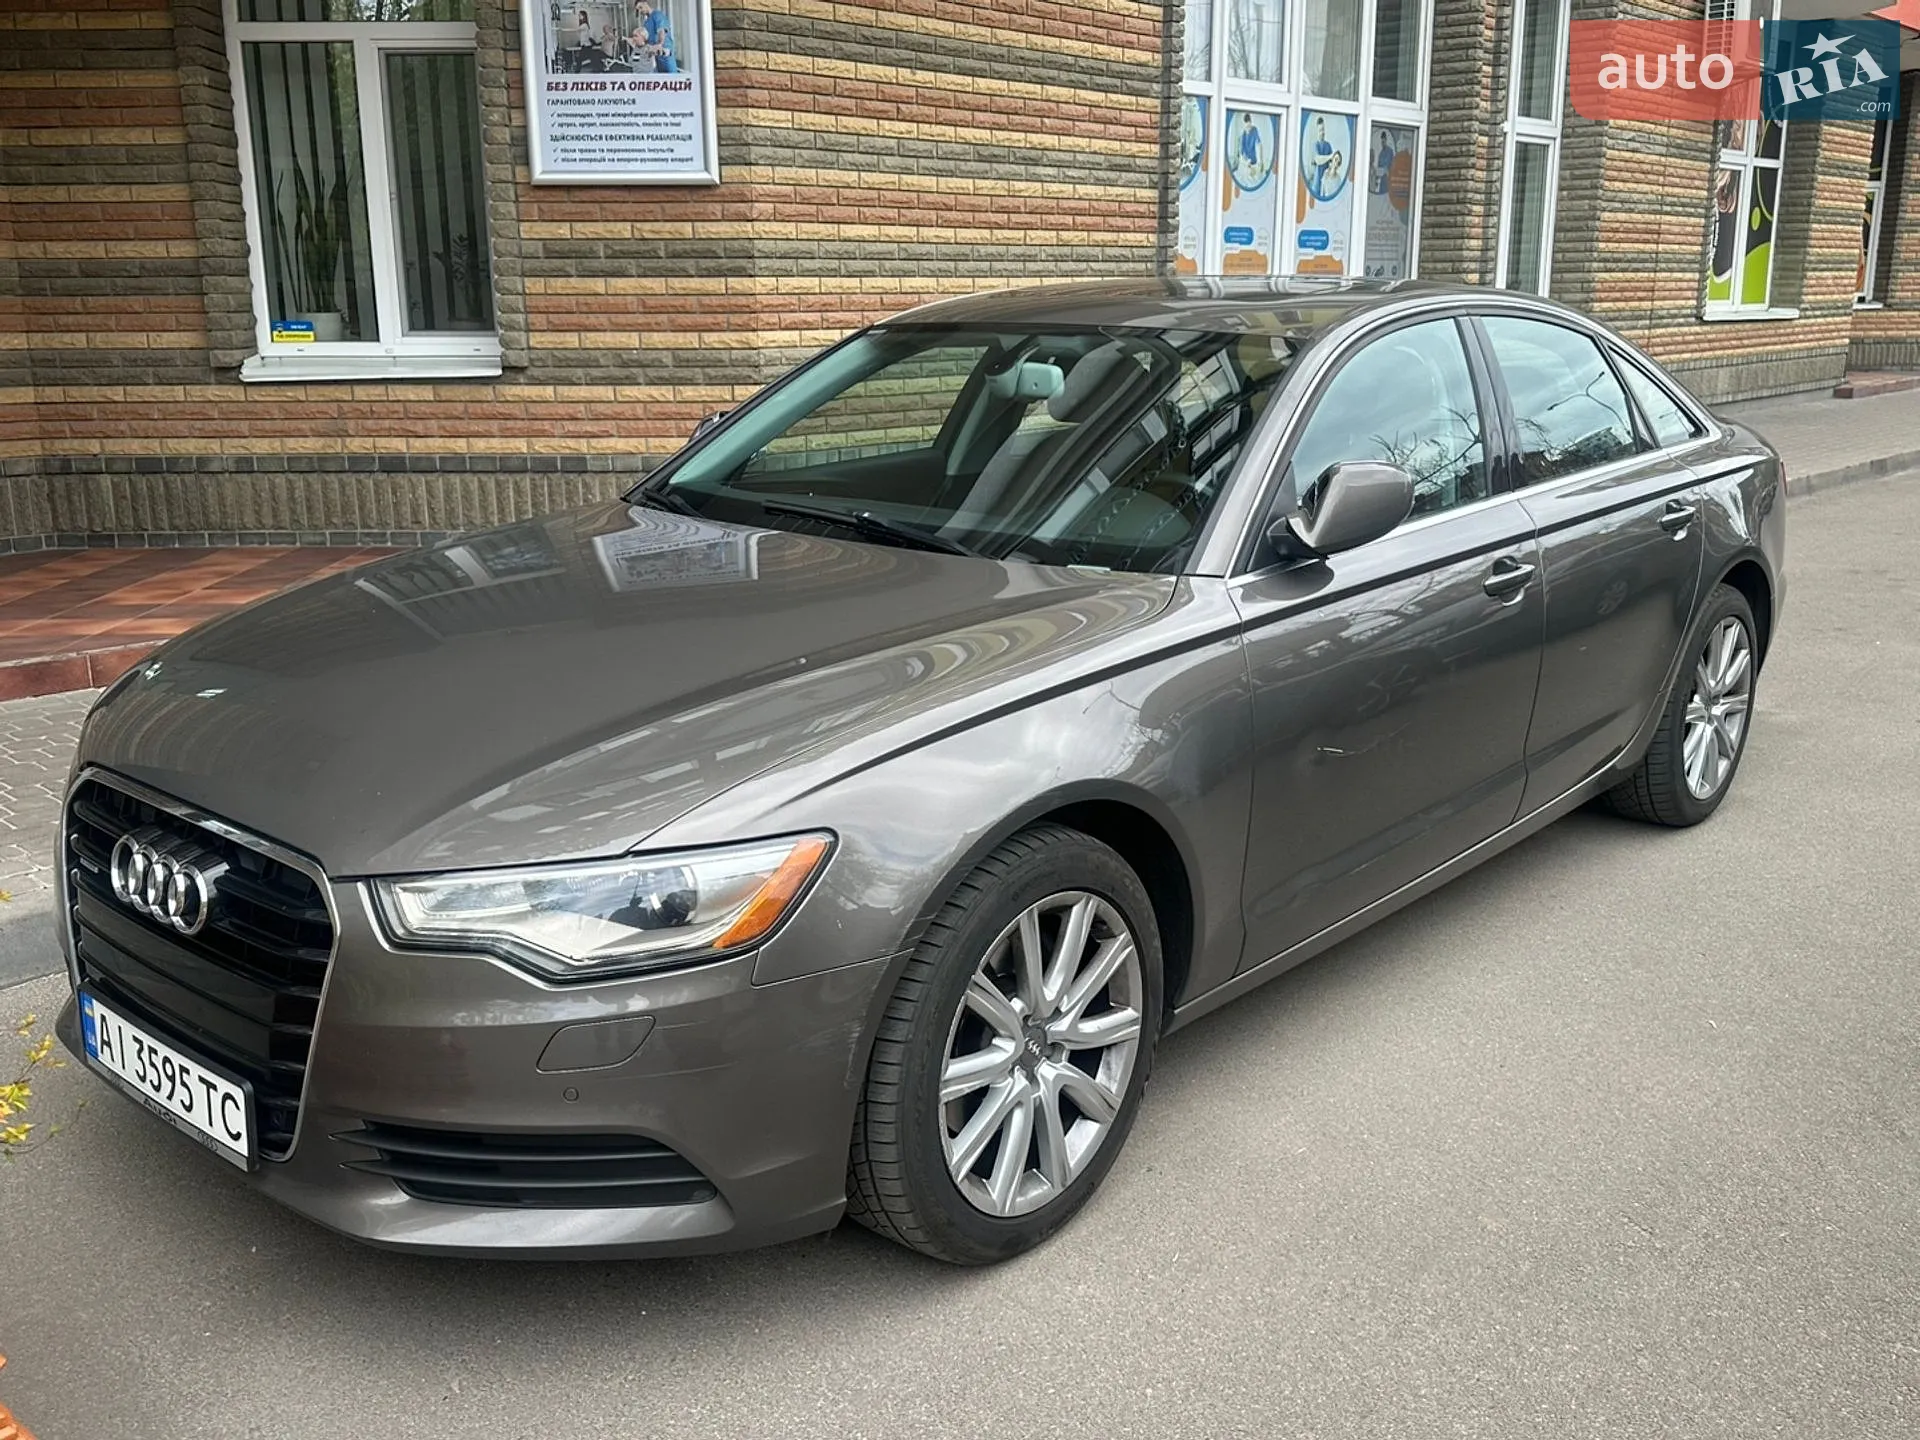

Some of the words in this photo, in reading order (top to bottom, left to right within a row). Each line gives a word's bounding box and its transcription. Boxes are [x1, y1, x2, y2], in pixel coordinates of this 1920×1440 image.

[546, 81, 568, 92] БЕЗ
[570, 81, 607, 92] ЛІКІВ
[610, 81, 627, 92] ТА
[629, 78, 693, 92] ОПЕРАЦІЙ
[546, 98, 596, 106] ГАРАНТОВАНО
[99, 1013, 126, 1070] AI
[131, 1034, 194, 1114] 3595
[197, 1074, 243, 1142] TC
